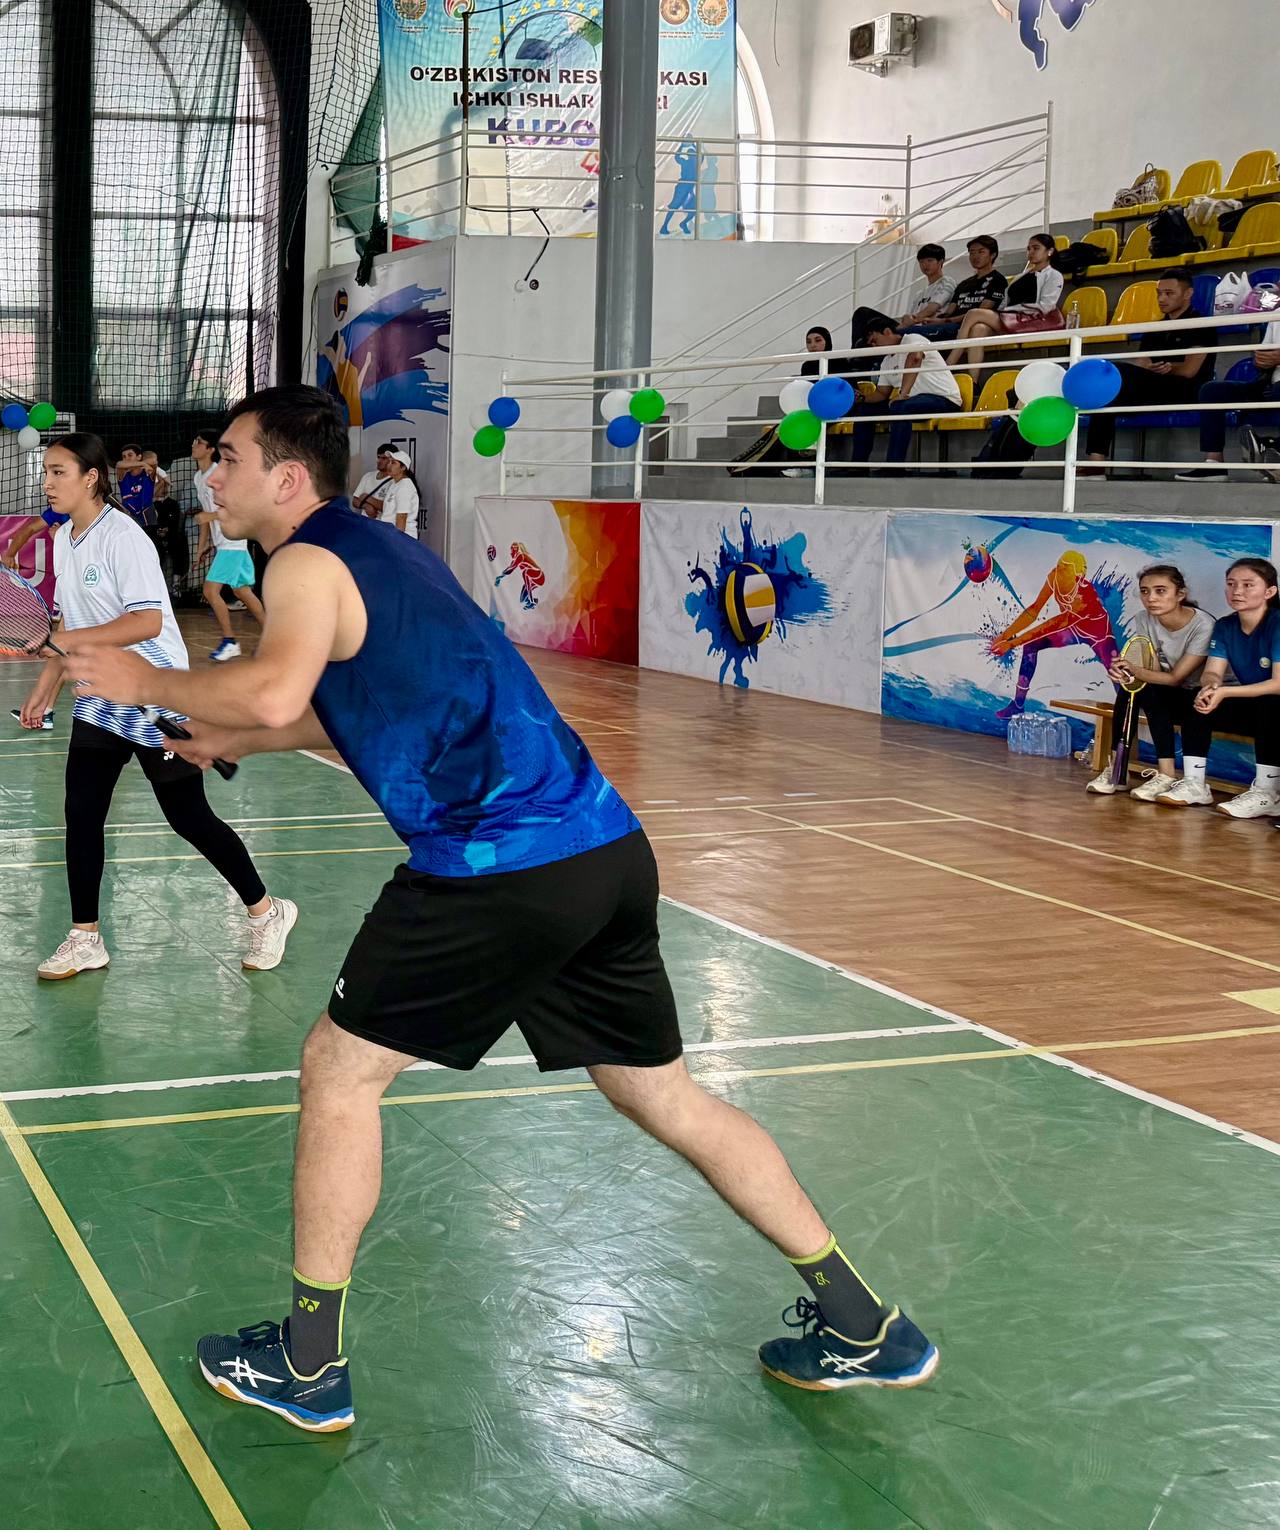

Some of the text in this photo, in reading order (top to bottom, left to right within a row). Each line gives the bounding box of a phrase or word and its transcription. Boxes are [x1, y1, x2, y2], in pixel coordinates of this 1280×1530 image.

[559, 69, 708, 87] RESKASI
[453, 91, 595, 109] ICHKI ISHLAR
[487, 117, 598, 147] KUBO
